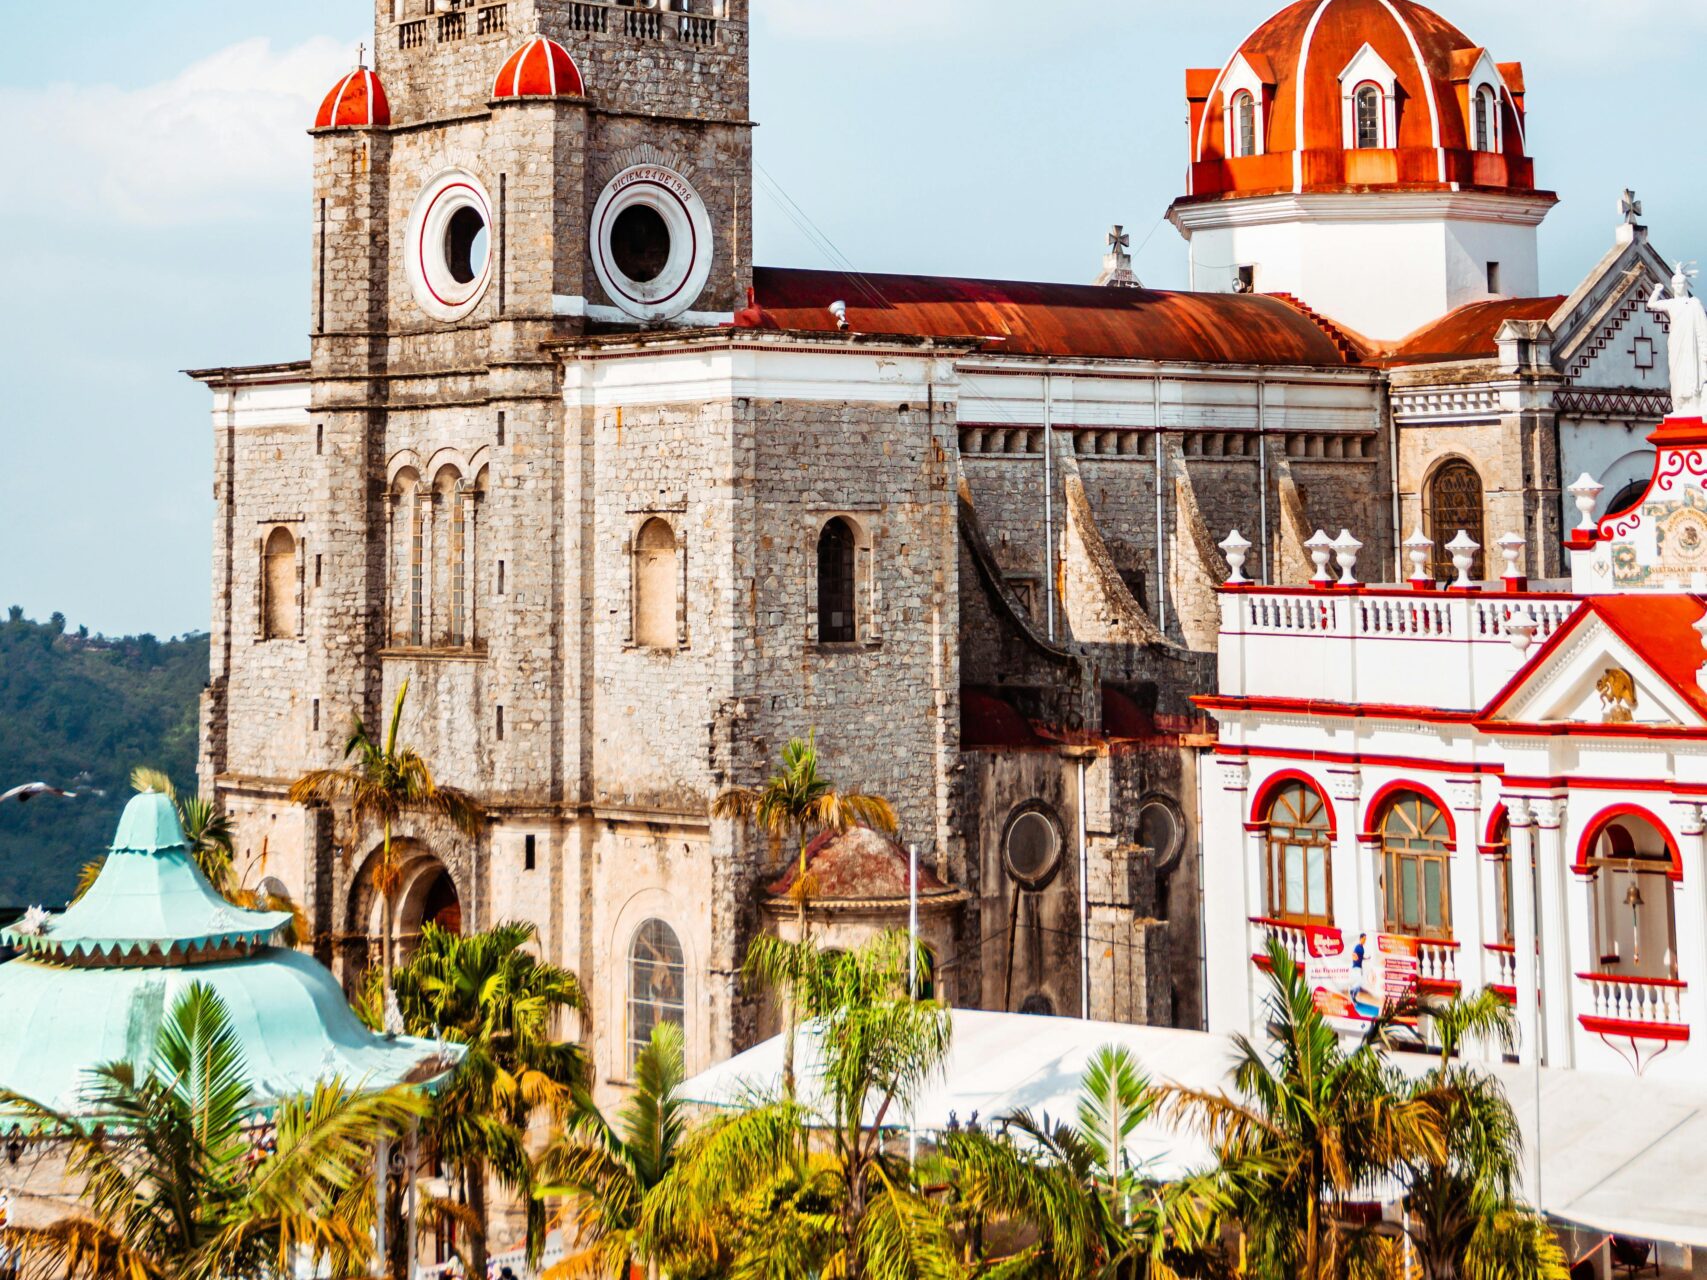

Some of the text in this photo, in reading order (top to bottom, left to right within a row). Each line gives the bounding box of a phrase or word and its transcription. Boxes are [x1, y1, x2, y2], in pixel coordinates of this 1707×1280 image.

[645, 169, 657, 179] 24
[658, 172, 672, 184] DE
[671, 180, 692, 201] 1938
